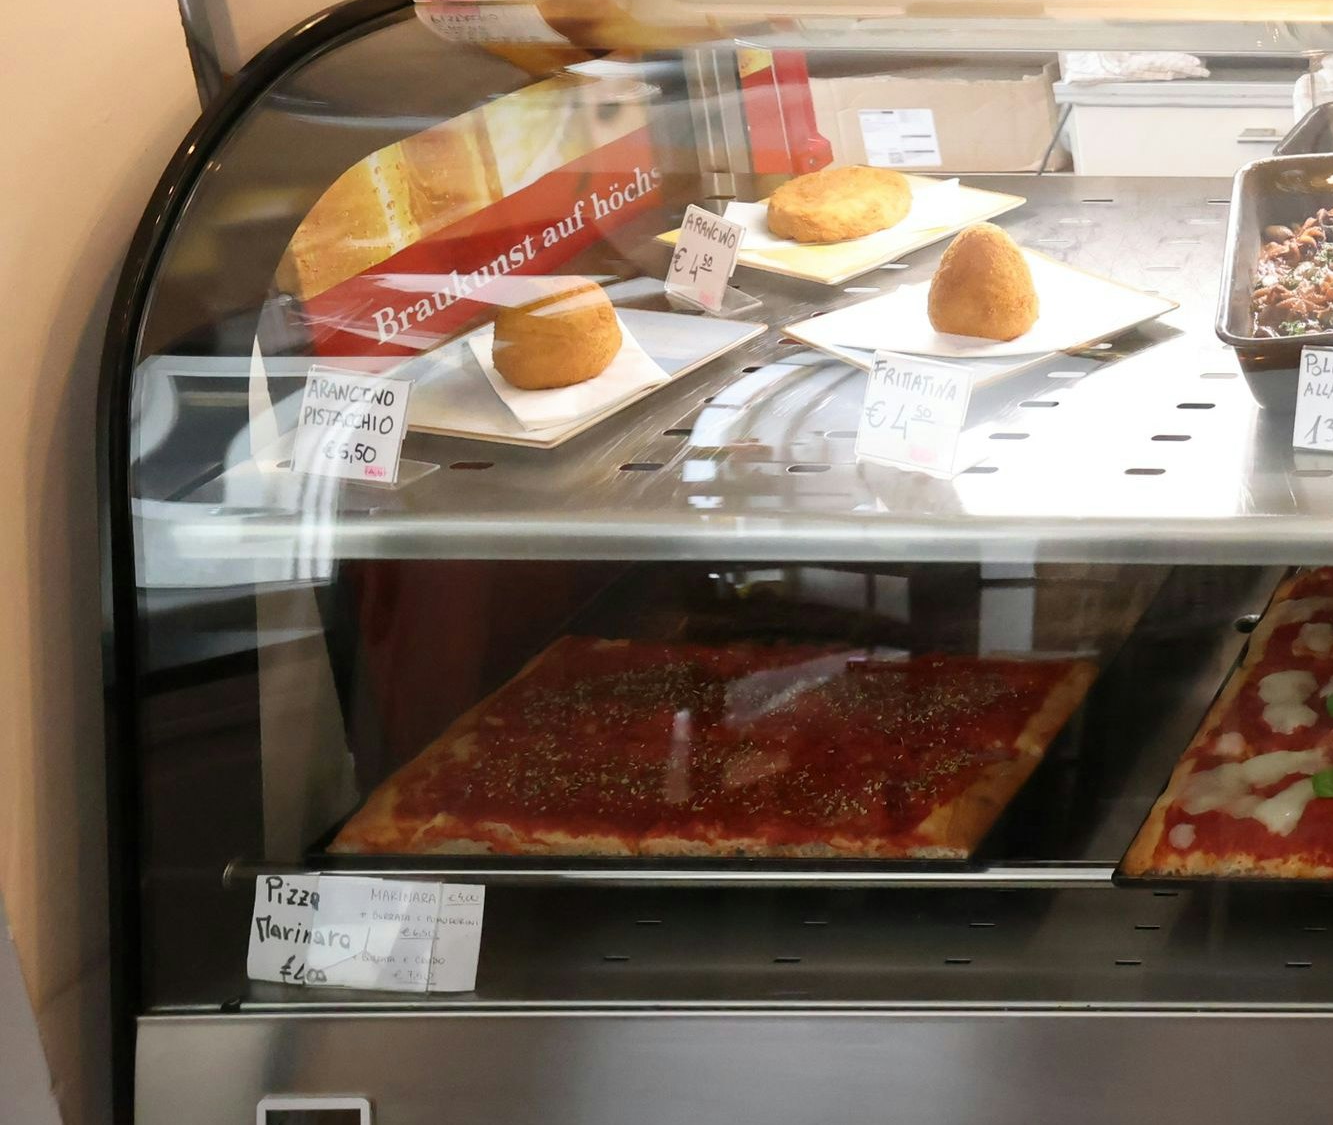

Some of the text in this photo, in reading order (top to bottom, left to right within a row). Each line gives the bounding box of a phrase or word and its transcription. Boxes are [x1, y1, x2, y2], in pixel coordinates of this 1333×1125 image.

[371, 234, 537, 346] Braukunst
[541, 200, 586, 249] auf
[307, 378, 395, 407] ARANCINO
[303, 405, 394, 435] PISTACCHIO
[265, 876, 320, 910] Pizza
